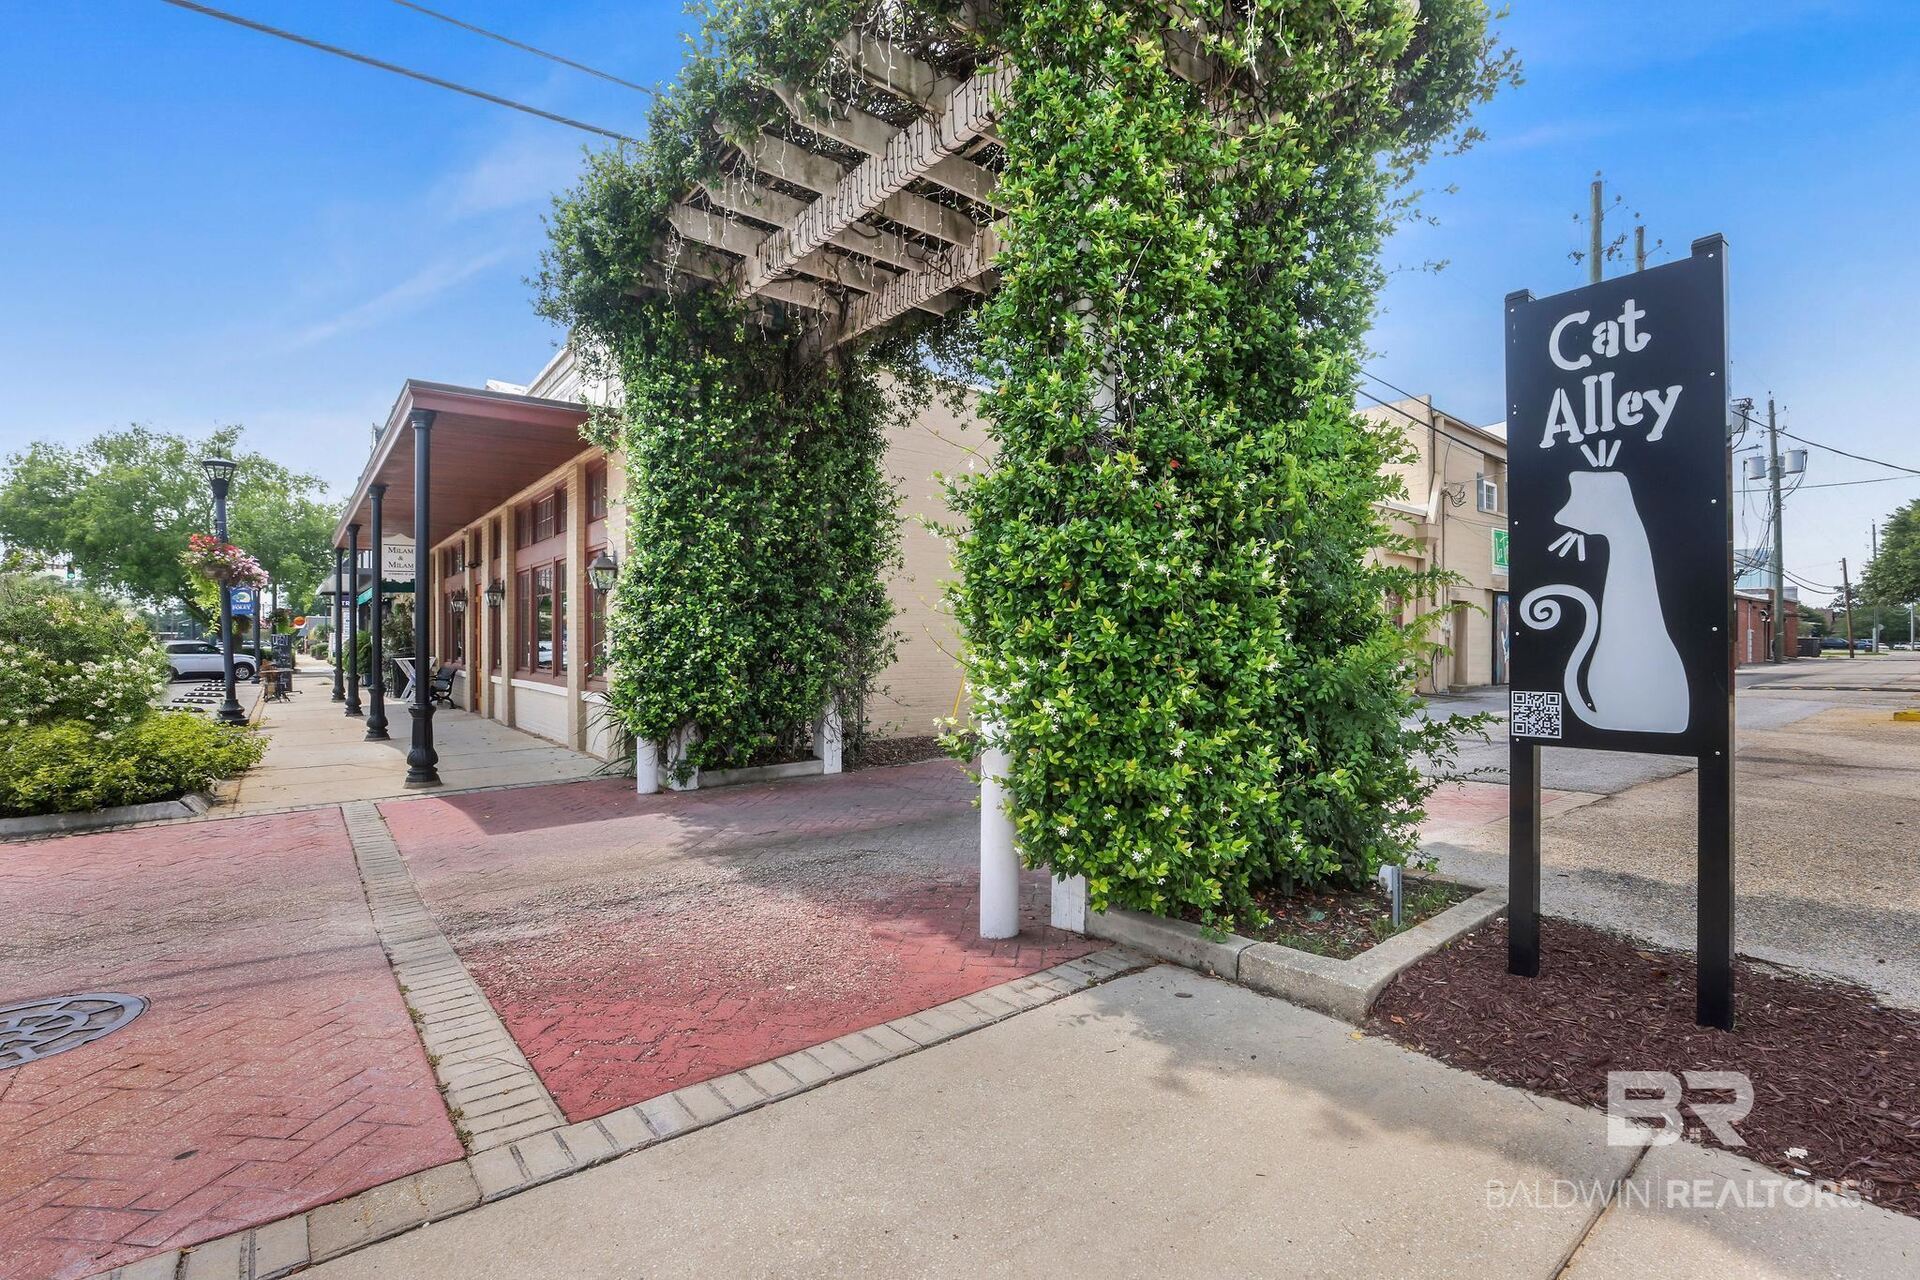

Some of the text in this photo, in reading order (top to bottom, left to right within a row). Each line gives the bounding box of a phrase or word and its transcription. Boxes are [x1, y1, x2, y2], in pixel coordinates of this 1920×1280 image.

[1549, 299, 1651, 371] Cat
[1539, 371, 1683, 448] Alley
[388, 546, 414, 554] MILAM
[388, 561, 414, 569] MILAM
